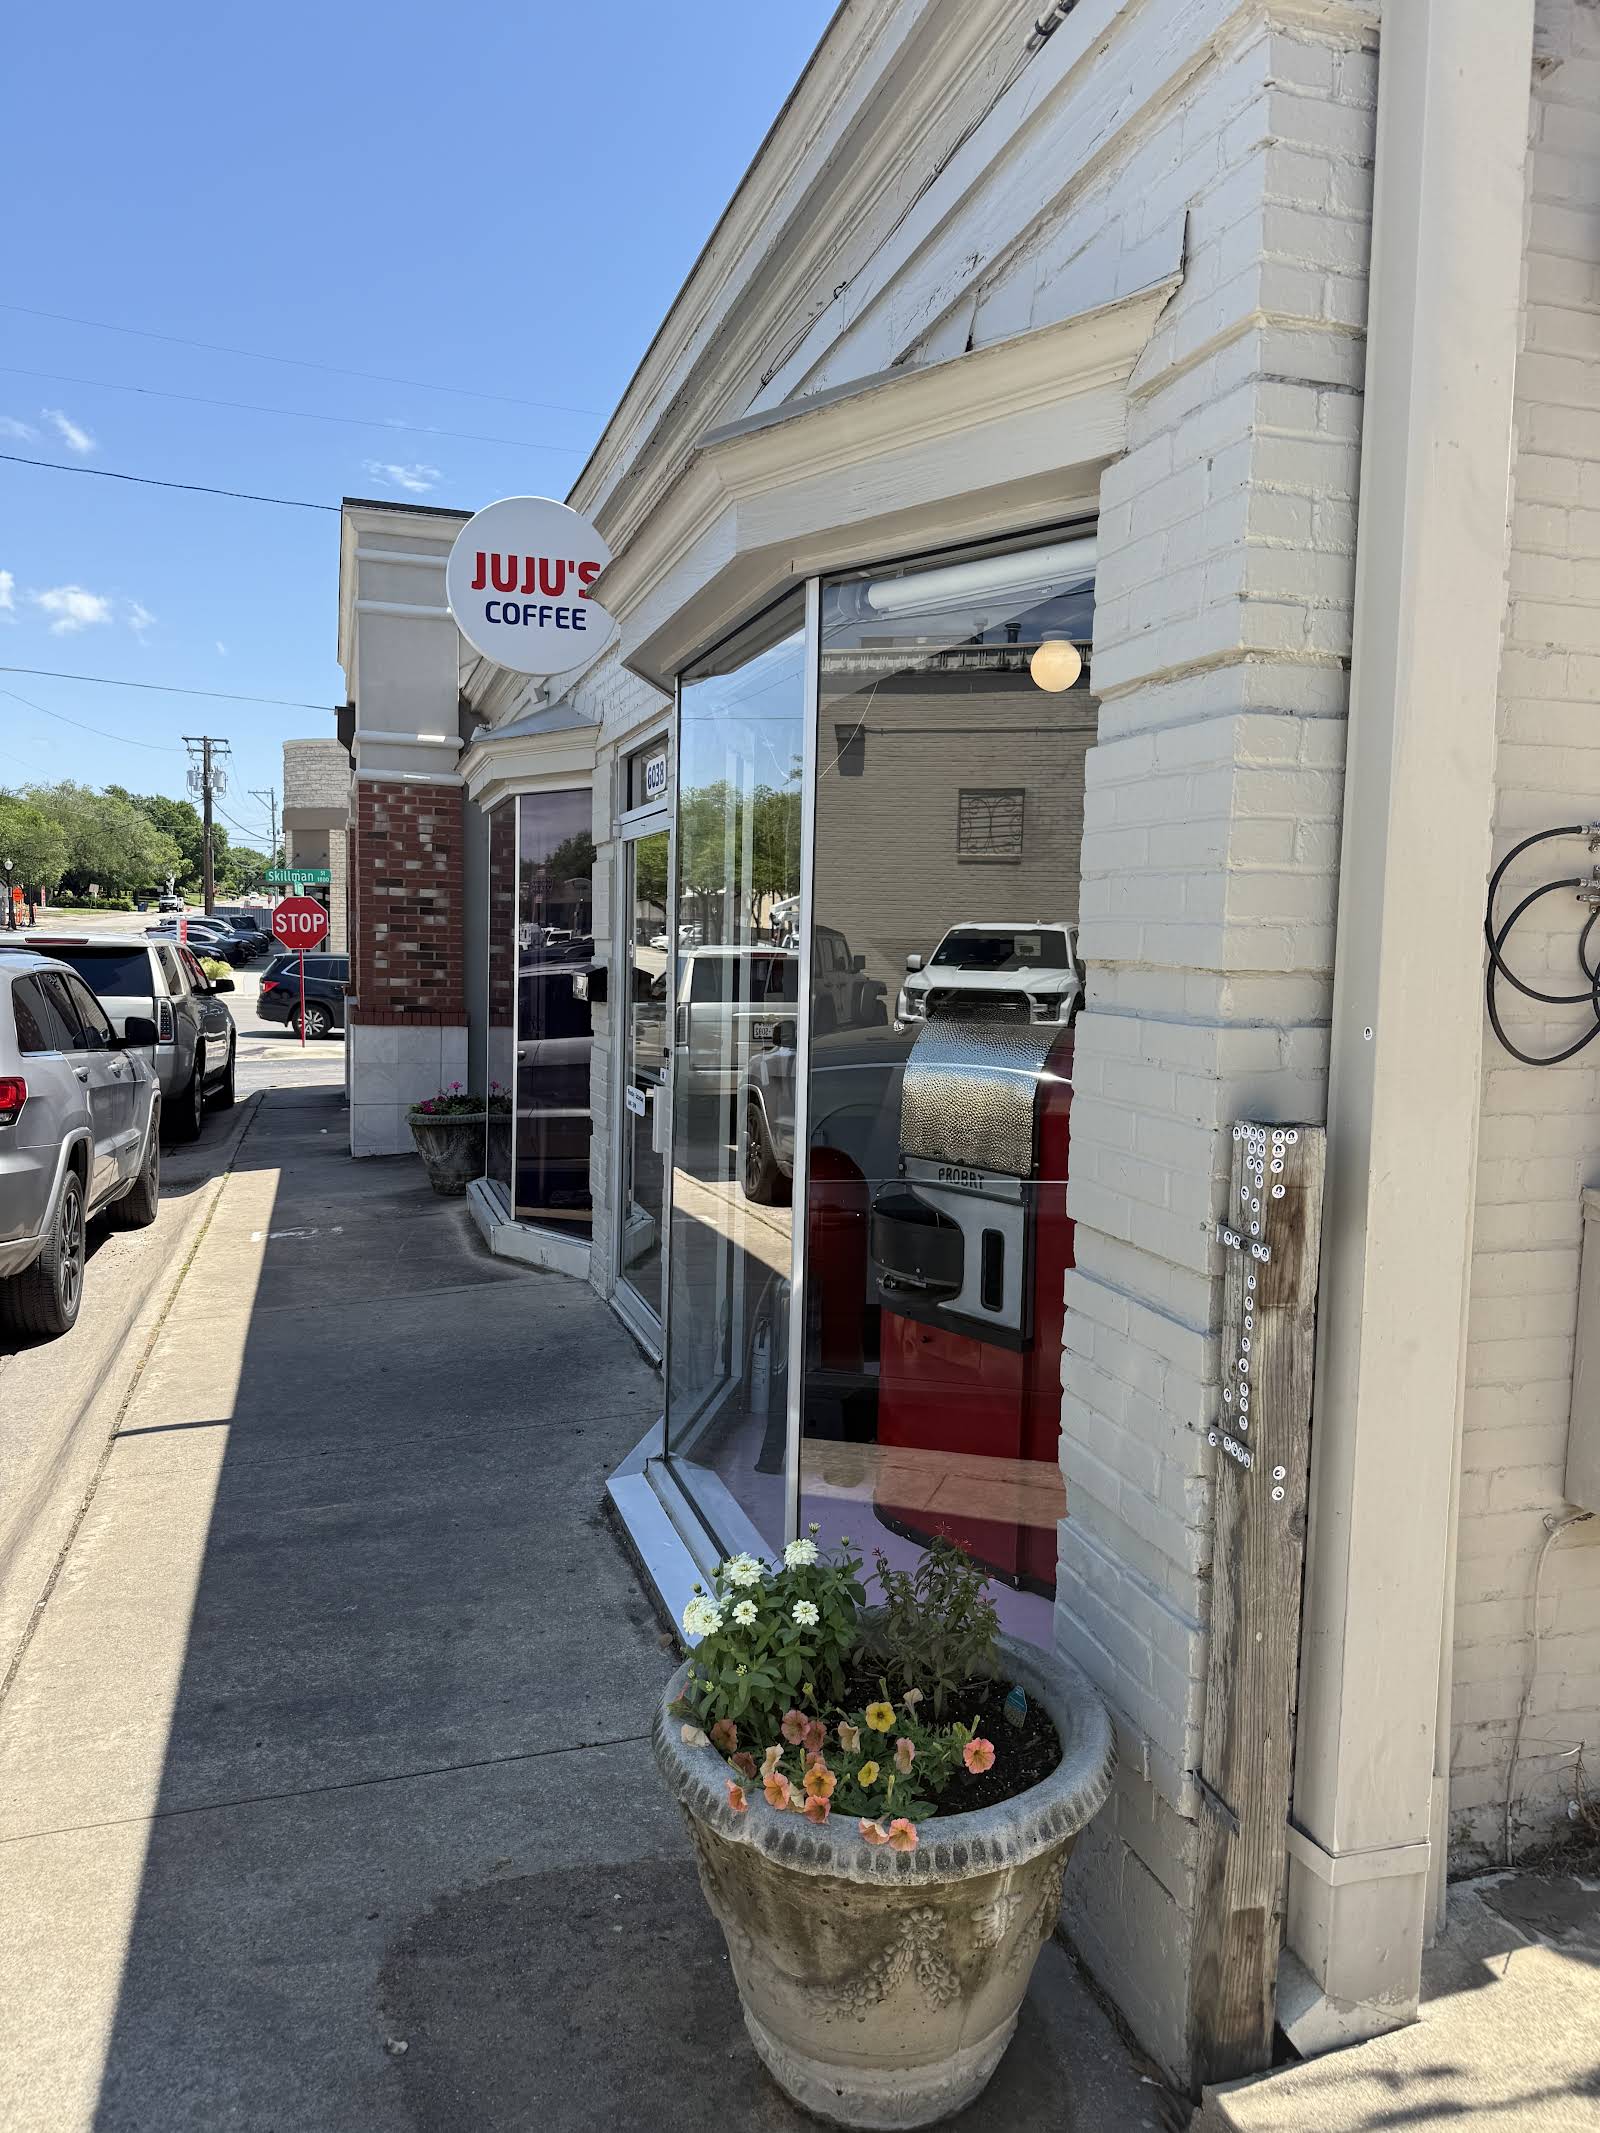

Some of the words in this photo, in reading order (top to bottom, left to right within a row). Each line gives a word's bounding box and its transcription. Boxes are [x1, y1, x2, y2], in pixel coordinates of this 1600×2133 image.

[471, 551, 601, 600] JUJU'S
[485, 600, 587, 631] COFFEE
[647, 760, 664, 790] 6038
[268, 870, 314, 882] Skillman
[275, 913, 325, 933] STOP
[938, 1167, 985, 1190] PROBAT
